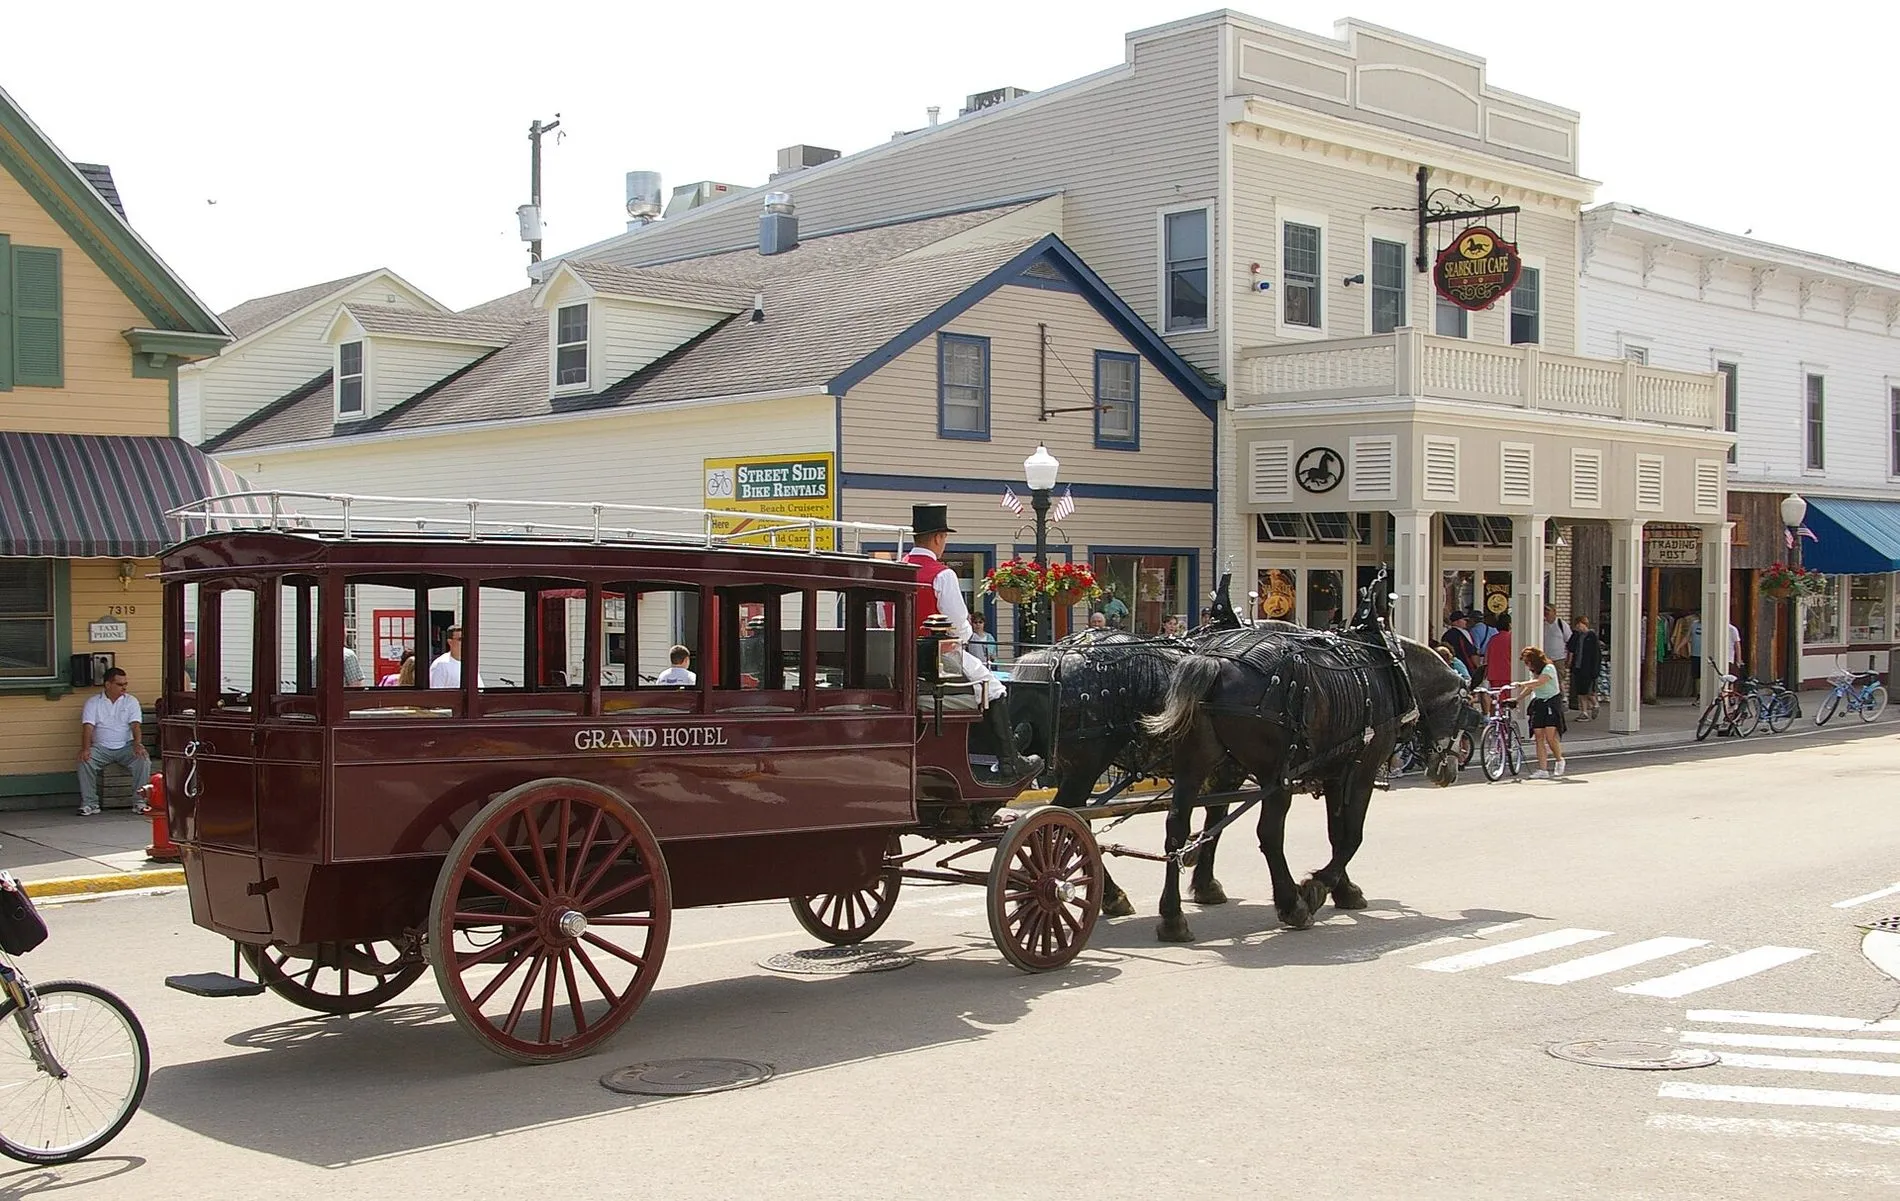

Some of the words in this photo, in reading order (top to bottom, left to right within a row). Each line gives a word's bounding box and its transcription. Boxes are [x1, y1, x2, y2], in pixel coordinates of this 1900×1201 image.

[1445, 259, 1487, 278] SEABISCUIT
[1487, 253, 1509, 274] CAFÉ
[738, 466, 789, 483] STREET
[792, 464, 826, 481] SIDE
[742, 484, 771, 498] BIKE
[773, 483, 826, 497] RENTALS
[760, 504, 785, 513] Beach
[787, 503, 825, 512] Cruisers
[763, 533, 785, 543] Cild
[788, 533, 825, 543] Carrirs
[1652, 540, 1695, 549] TRADING
[1660, 551, 1686, 559] POST
[108, 605, 136, 615] 7319
[574, 729, 657, 750] GRAND
[662, 727, 728, 747] HOTEL
